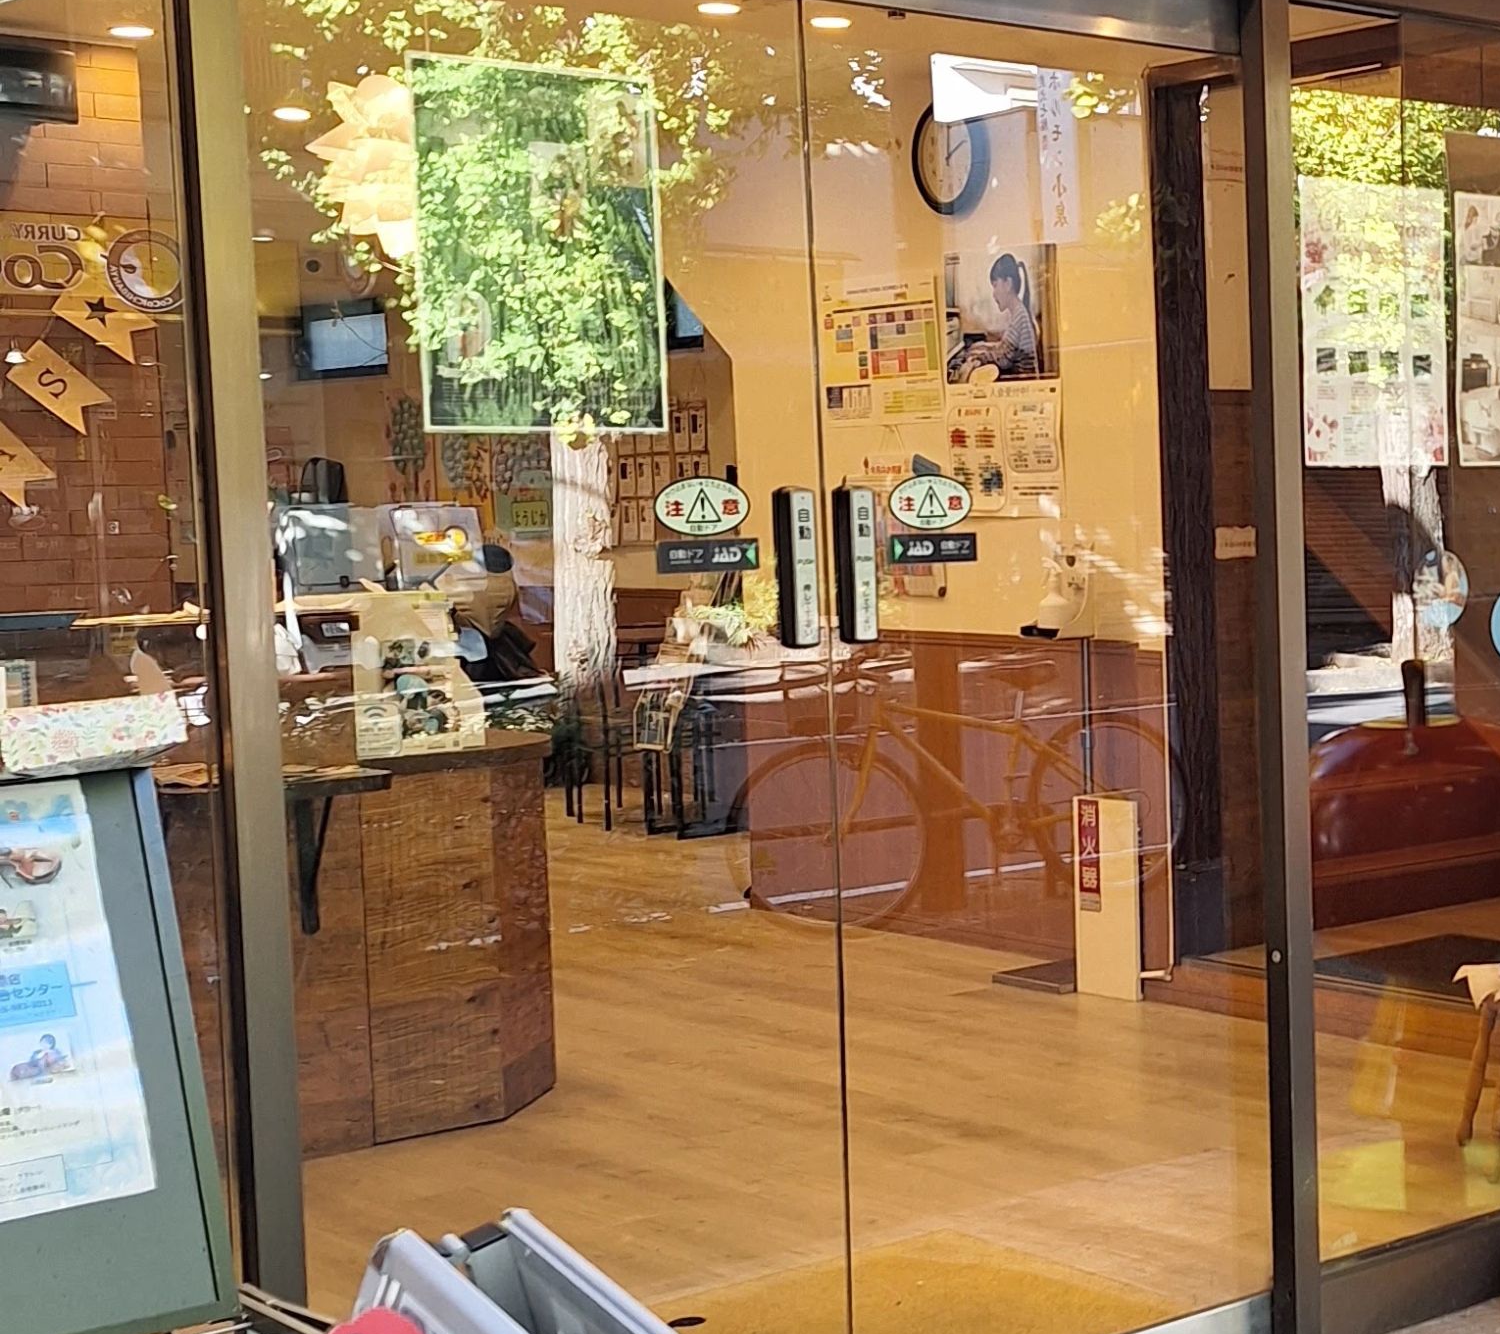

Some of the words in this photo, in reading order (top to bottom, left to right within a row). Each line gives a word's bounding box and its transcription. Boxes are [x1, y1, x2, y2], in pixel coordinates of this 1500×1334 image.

[665, 500, 685, 517] 注
[721, 499, 740, 515] 意
[899, 496, 915, 512] 注
[798, 508, 812, 540] 自動
[858, 506, 871, 537] 自動
[1081, 804, 1098, 889] 消火器
